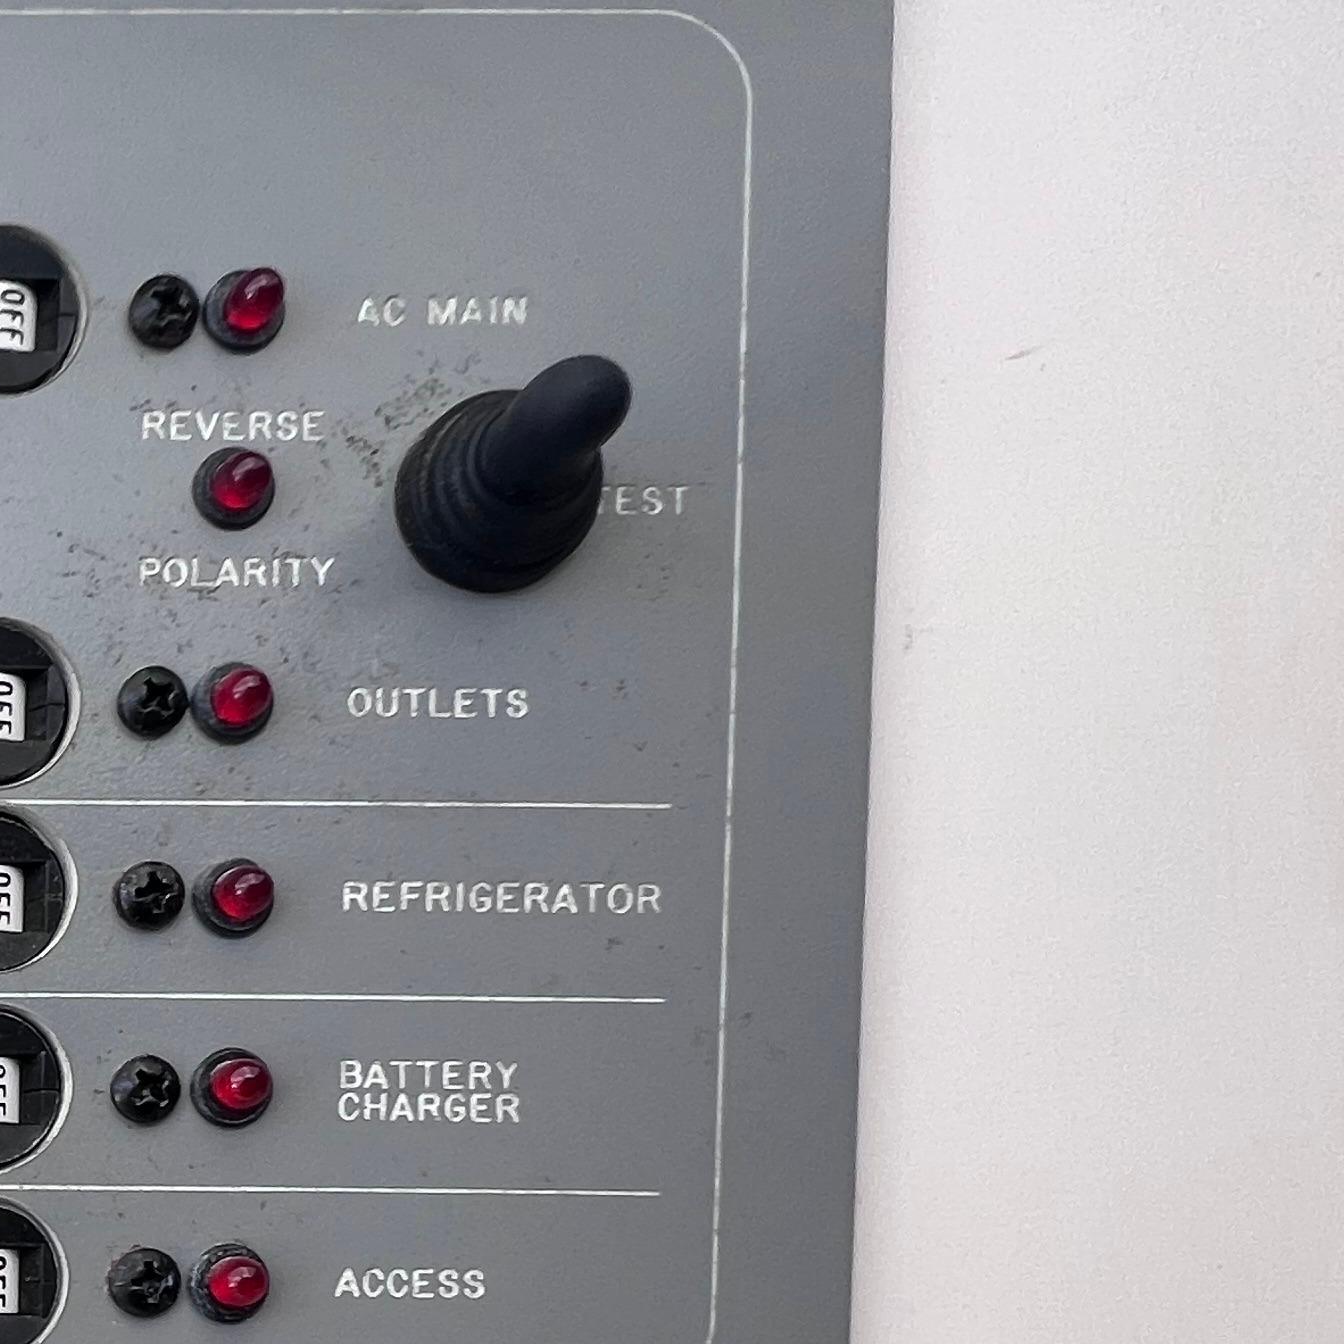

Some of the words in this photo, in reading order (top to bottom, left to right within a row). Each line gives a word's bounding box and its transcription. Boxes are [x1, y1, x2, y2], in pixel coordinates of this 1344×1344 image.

[357, 296, 405, 327] AC
[427, 296, 528, 326] MAIN
[141, 410, 325, 442] REVERSE
[138, 556, 336, 588] POLARITY
[346, 687, 530, 720] OUTLETS
[341, 880, 663, 915] REFRIGERATOR
[338, 1059, 519, 1091] BATTERY
[337, 1091, 521, 1124] CHARGER
[333, 1268, 487, 1300] ACCESS
